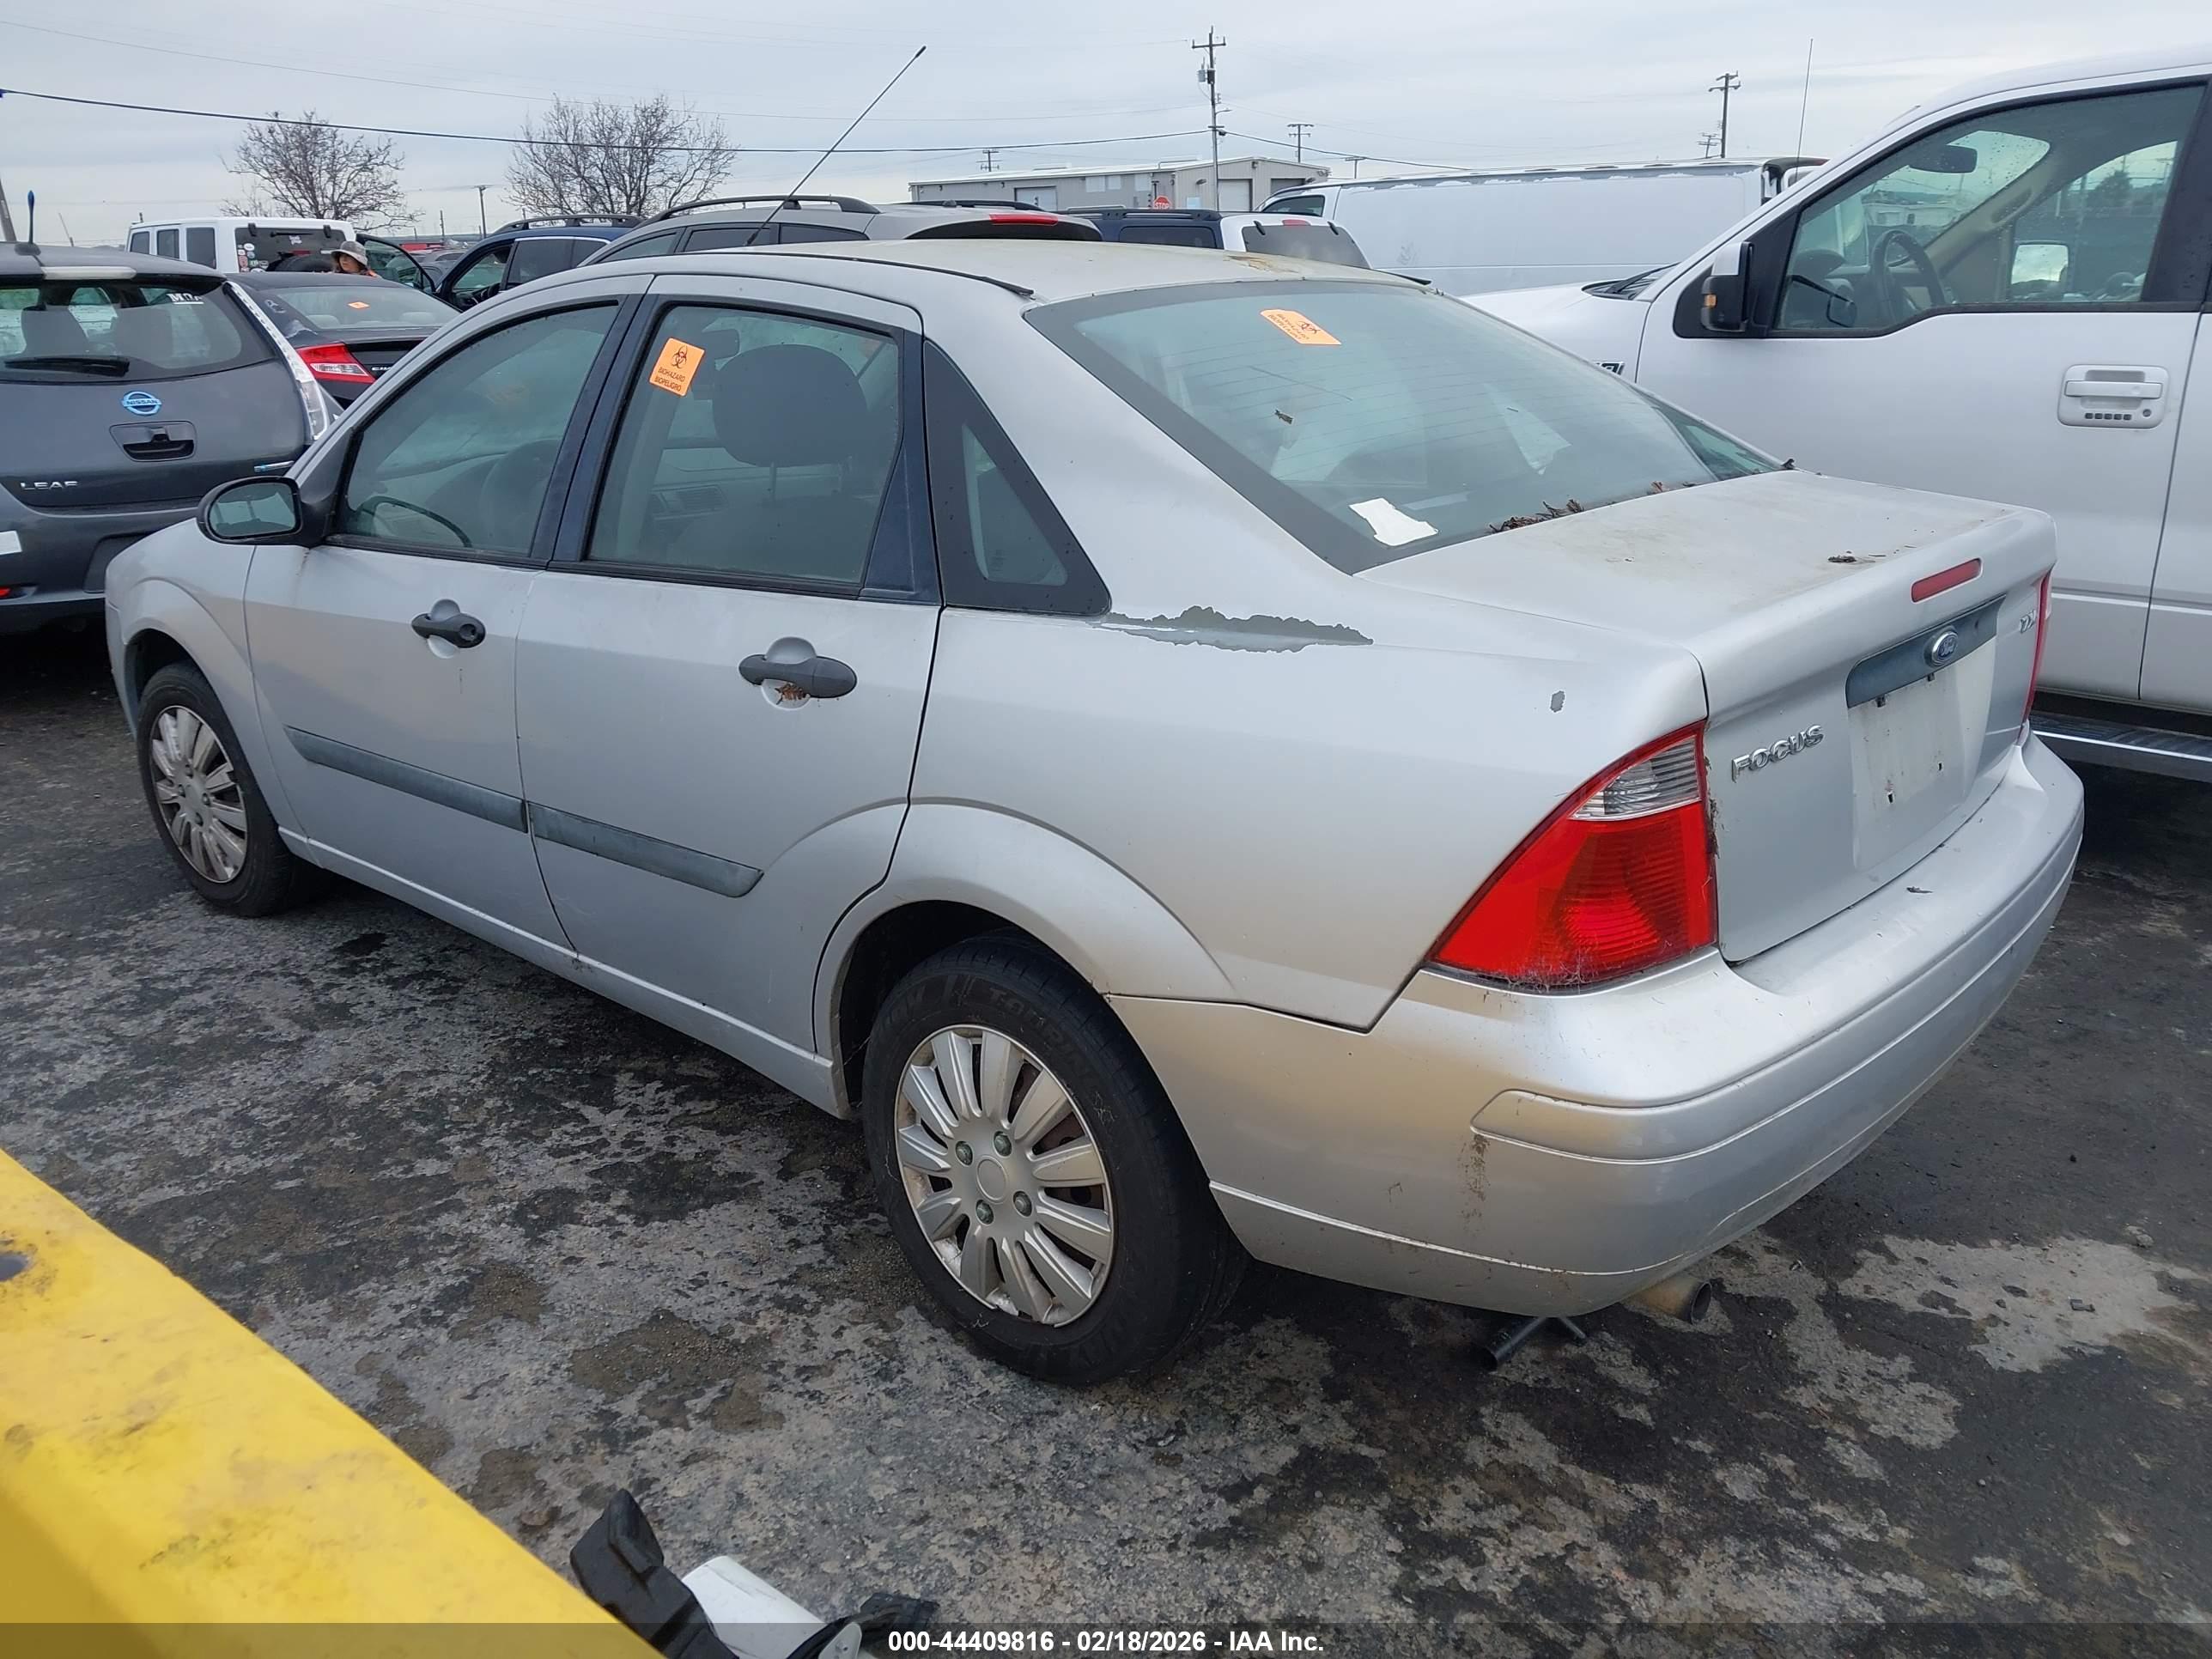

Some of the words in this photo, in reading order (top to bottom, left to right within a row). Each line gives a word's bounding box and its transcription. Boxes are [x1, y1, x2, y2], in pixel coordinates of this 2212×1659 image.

[658, 367, 686, 382] BIOHAZARD
[654, 376, 683, 392] BIOPELIGRO
[20, 481, 78, 490] LEAF
[1731, 725, 1824, 783] FOCUS
